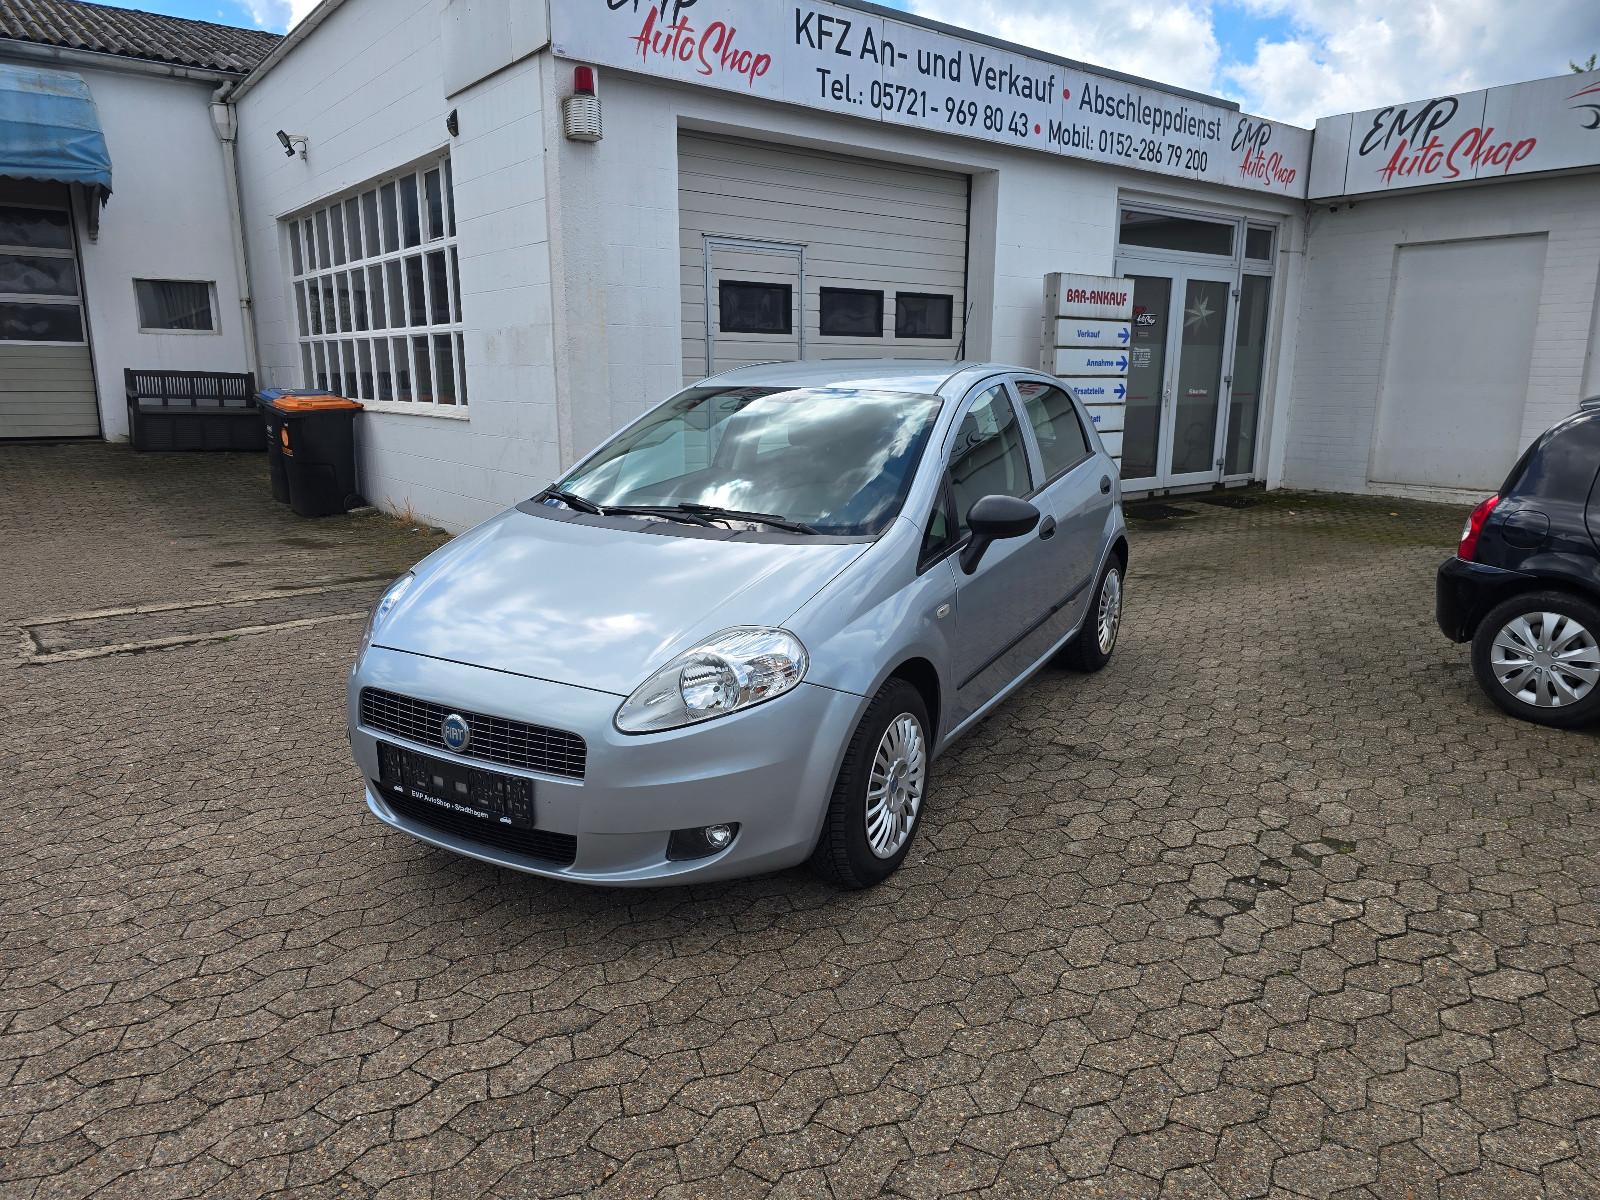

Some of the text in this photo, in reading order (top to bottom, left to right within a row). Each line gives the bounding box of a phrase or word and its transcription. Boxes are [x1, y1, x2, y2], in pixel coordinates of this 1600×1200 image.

[795, 8, 1222, 142] KFZ An- und Verkauf Abschleppdienst
[816, 67, 863, 105] Tel.:
[945, 97, 978, 126] 969
[983, 105, 1003, 133] 80
[1008, 111, 1028, 137] 43
[1048, 119, 1094, 150] Mobil:
[1099, 129, 1162, 164] 0152-286
[1167, 144, 1182, 167] 79
[1185, 150, 1208, 172] 200
[1359, 96, 1459, 156] EMP
[1231, 117, 1272, 157] EMP
[1066, 288, 1127, 306] BAR-ANKAUF
[1077, 329, 1101, 338] Verkauf
[1086, 358, 1114, 367] Annahme
[445, 725, 464, 740] FIAT
[454, 803, 489, 819] Stadthagen
